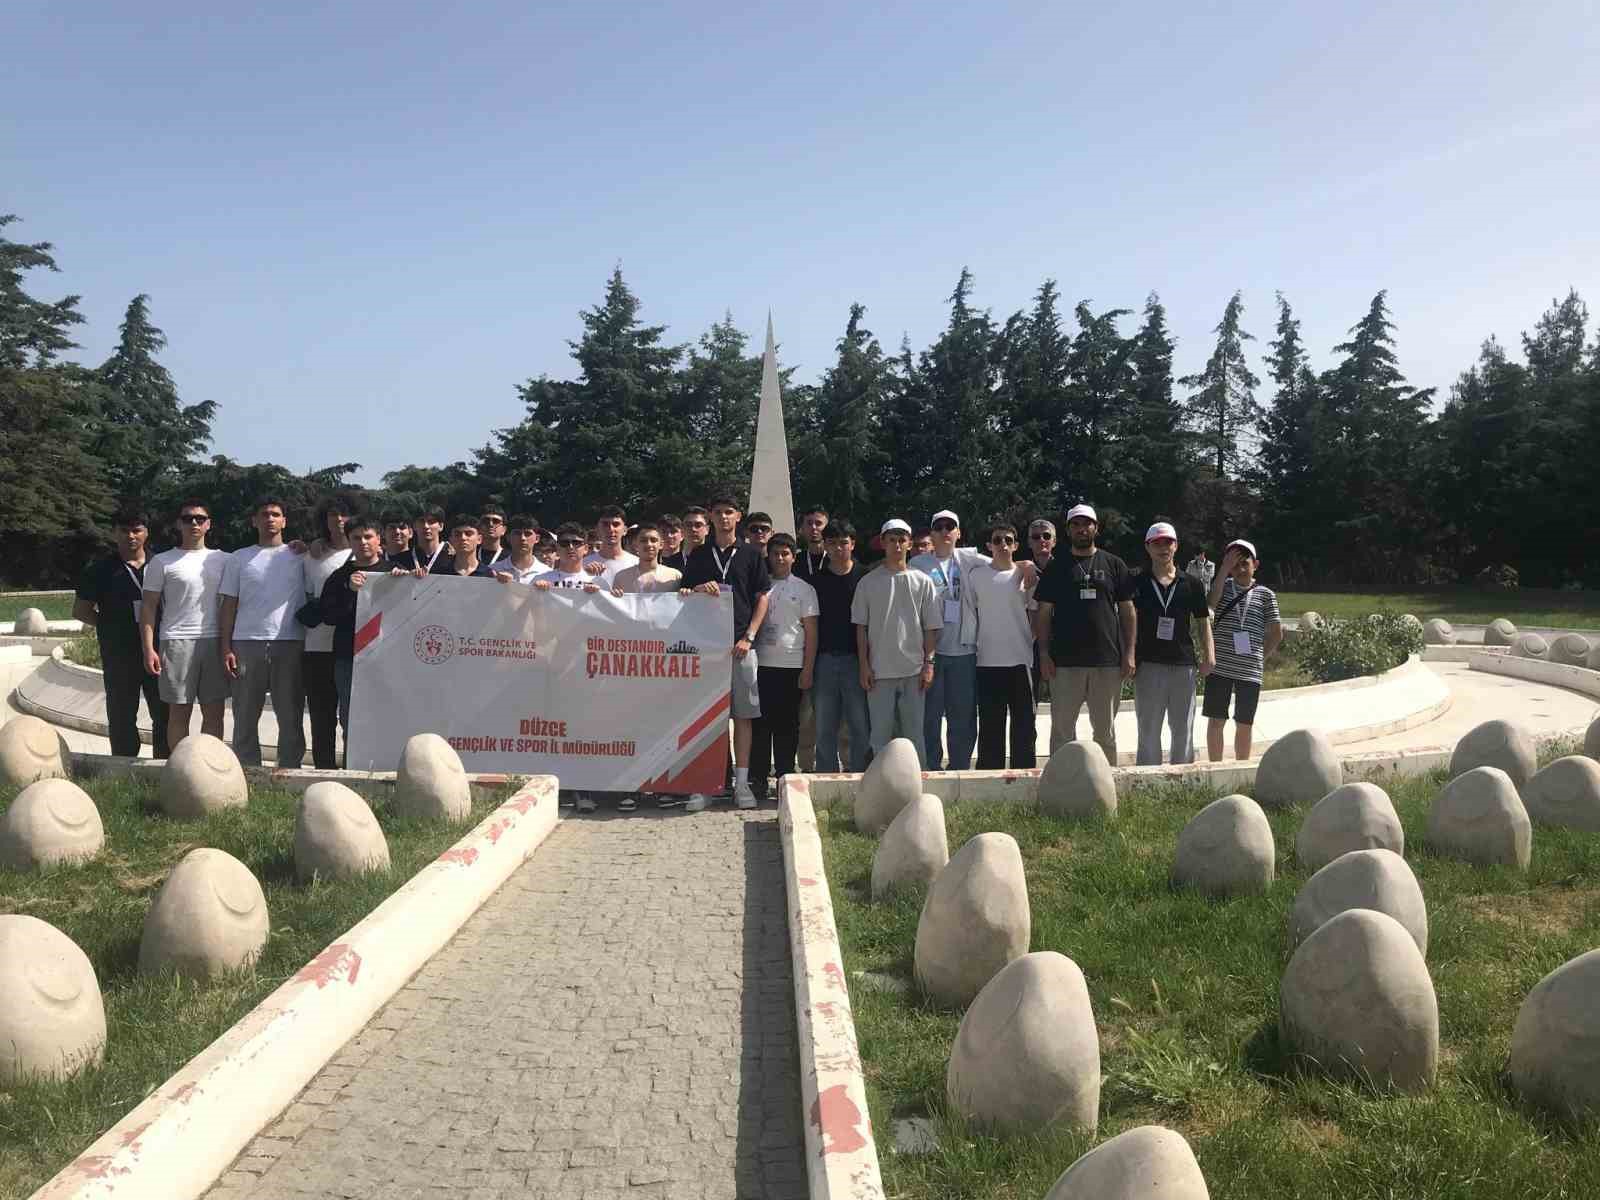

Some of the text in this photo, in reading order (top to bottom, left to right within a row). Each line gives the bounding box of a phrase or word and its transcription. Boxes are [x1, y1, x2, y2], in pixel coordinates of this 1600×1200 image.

[458, 648, 484, 657] SPOR
[525, 640, 537, 650] VE
[586, 635, 665, 653] BİR DESTANDIR
[585, 652, 701, 678] ÇANAKKALE
[519, 716, 568, 737] DÜZCE
[448, 735, 637, 757] GENÇLİK VE SPOR İL MÜDÜRLÜĞÜ
